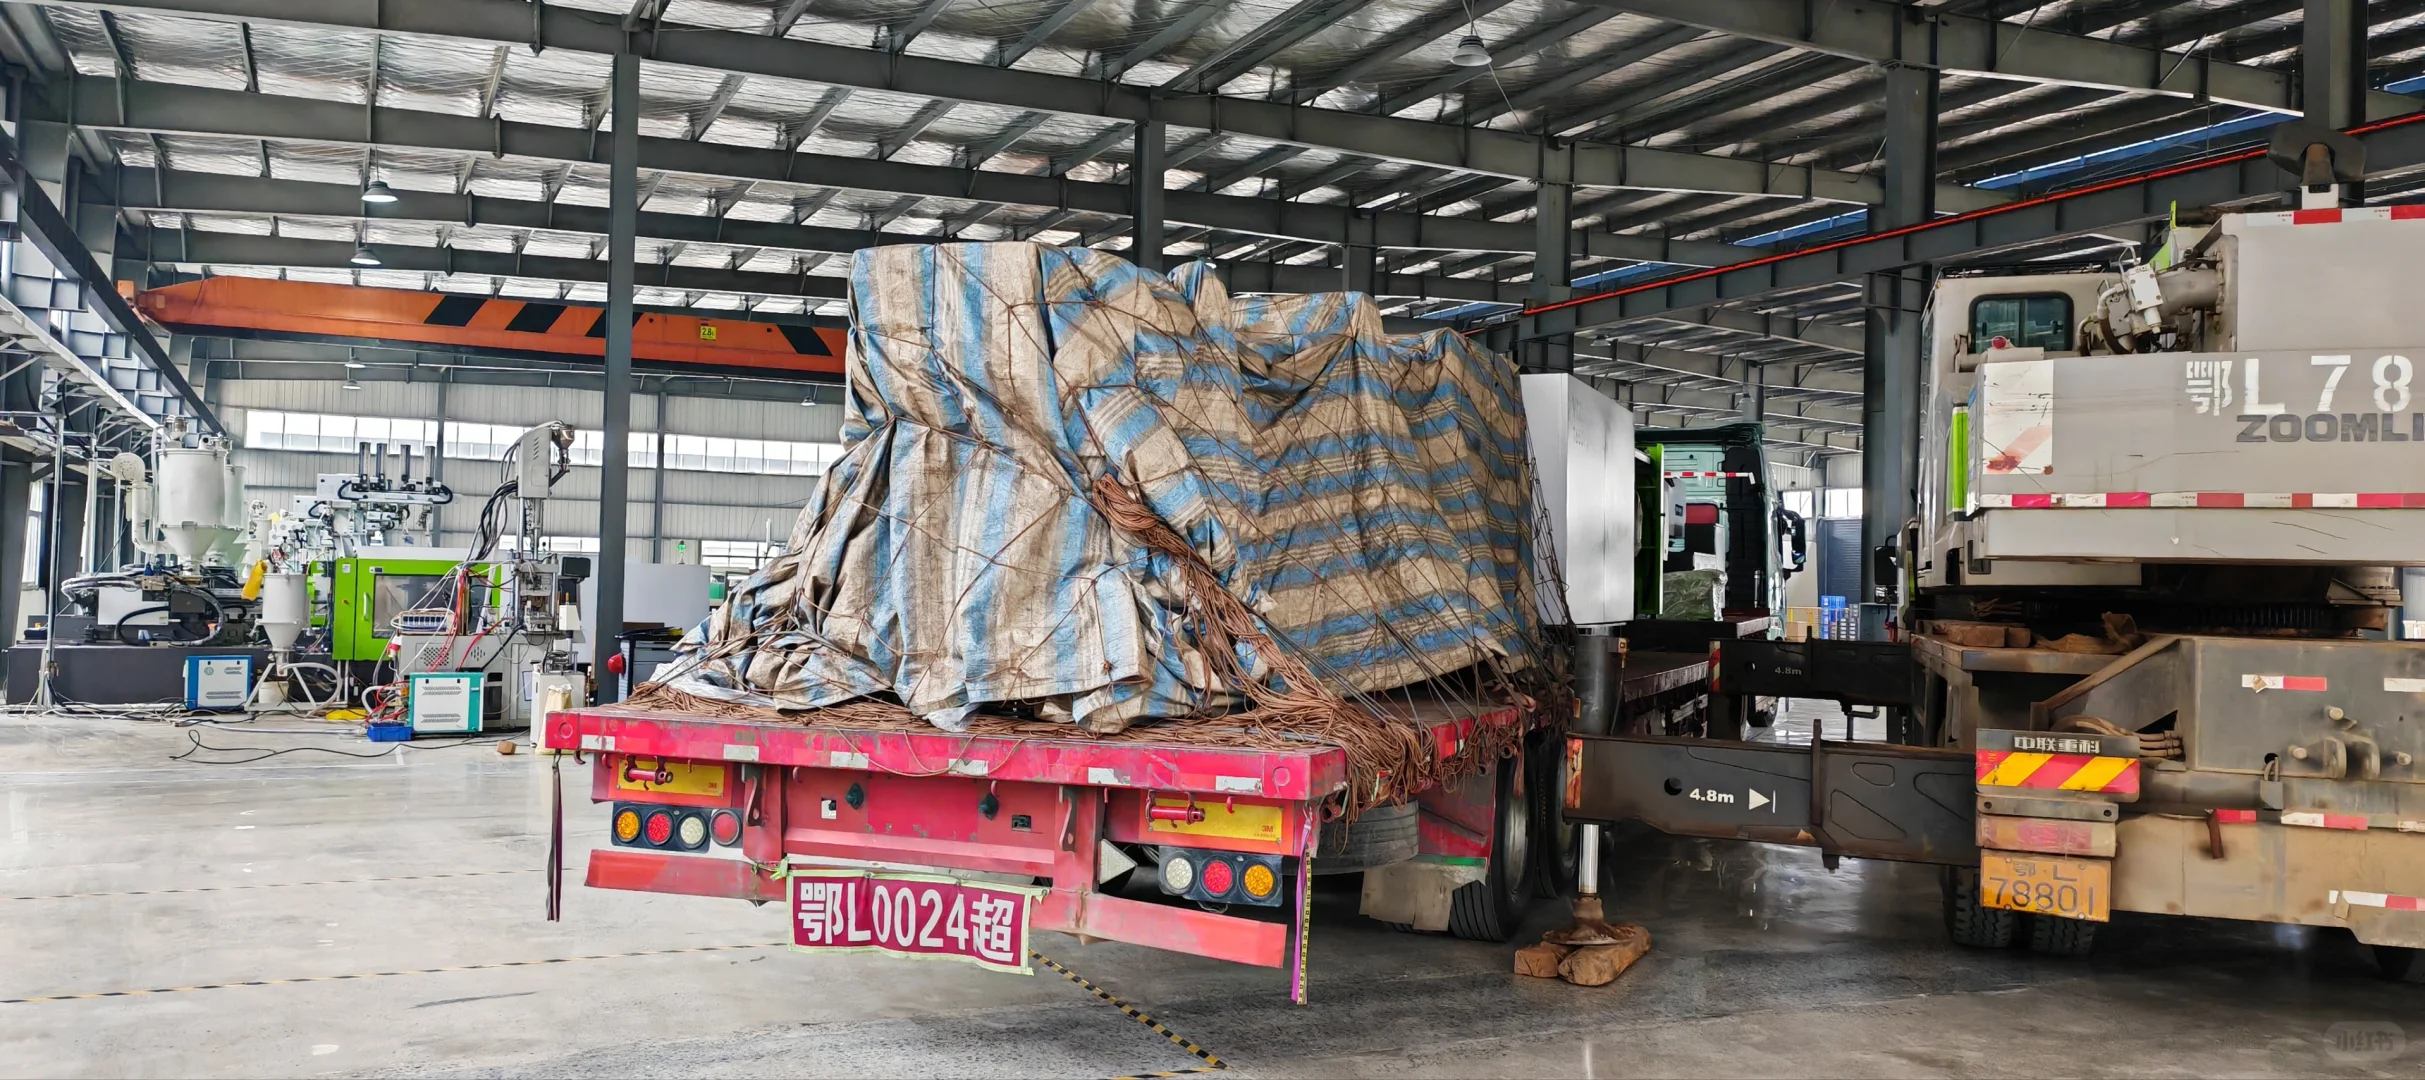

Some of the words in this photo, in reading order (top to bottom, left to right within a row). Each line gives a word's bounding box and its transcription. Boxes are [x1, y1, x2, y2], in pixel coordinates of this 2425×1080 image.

[1774, 666, 1802, 676] 4.8m
[2014, 736, 2100, 754] 中联重科
[1689, 787, 1734, 804] 4.8m
[1261, 825, 1274, 833] 3M
[1989, 876, 2094, 916] 78801
[797, 881, 1015, 963] 鄂L0024超
